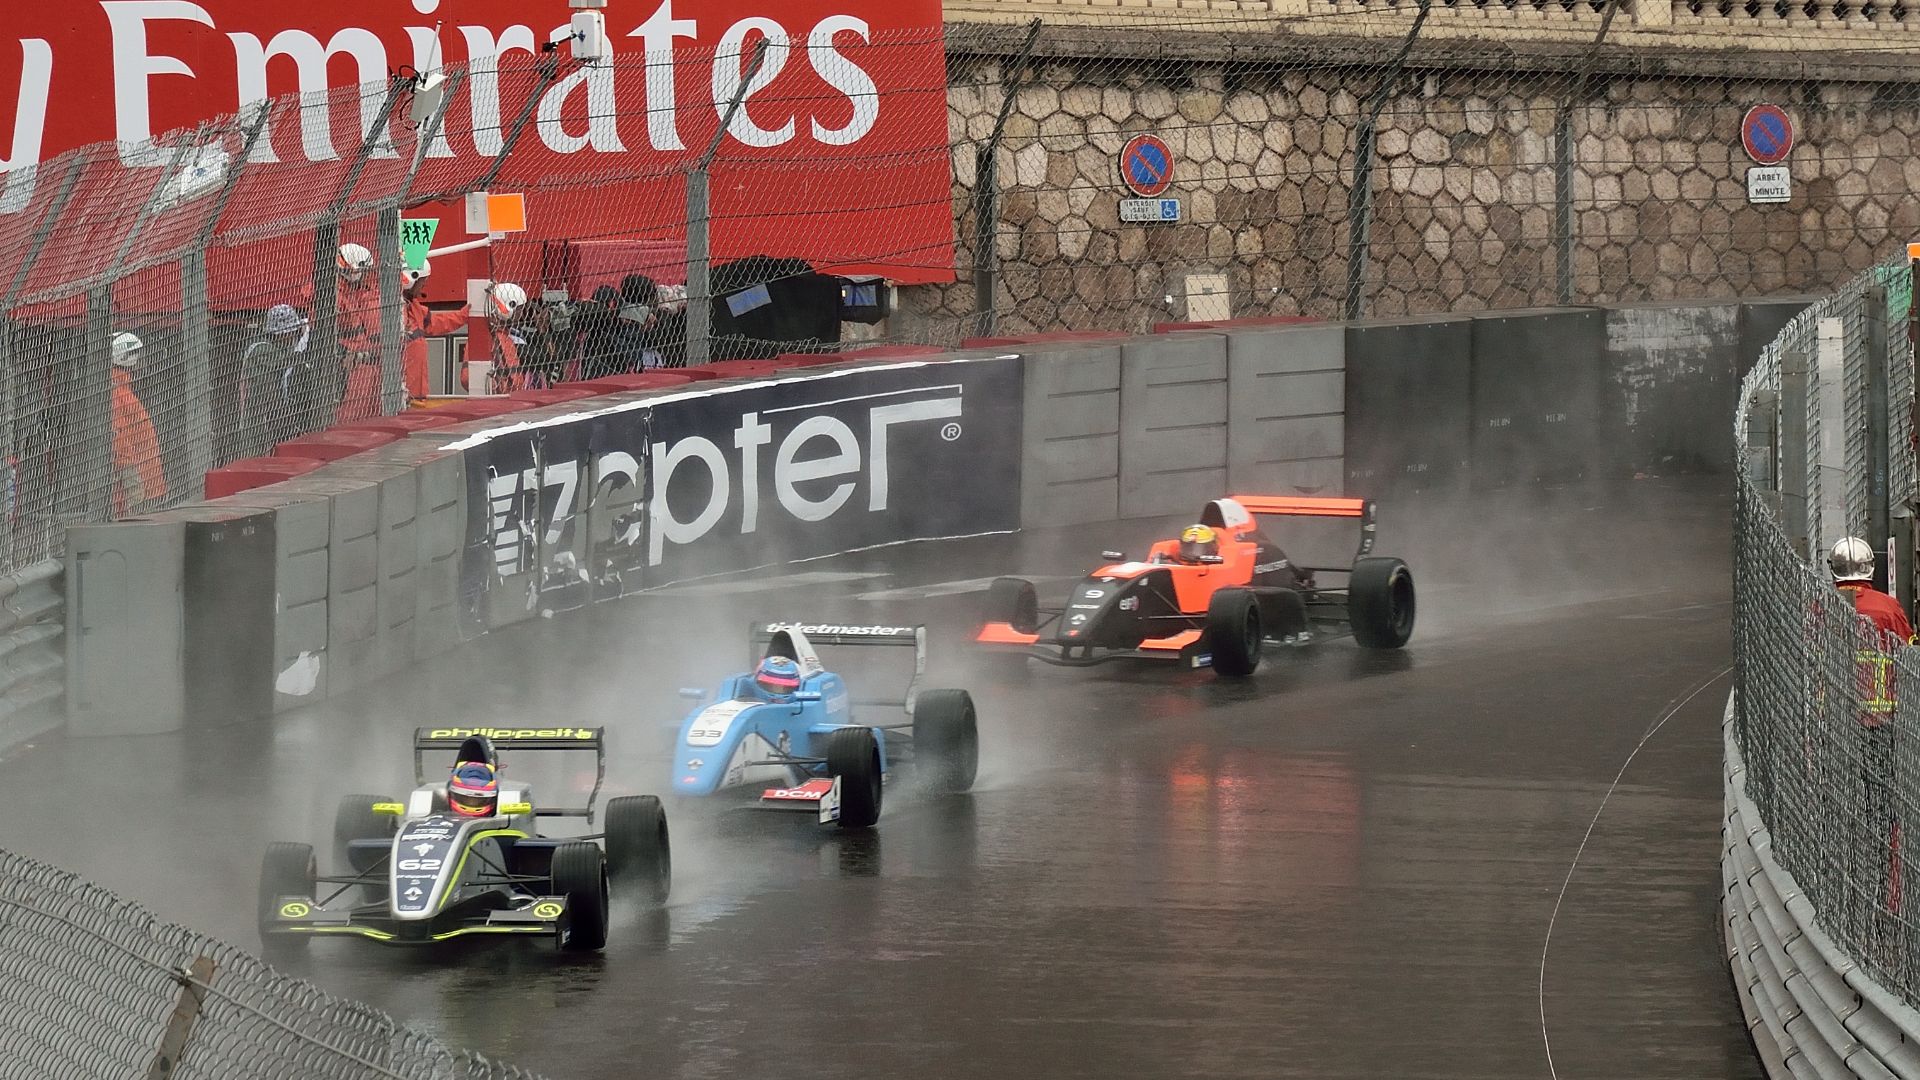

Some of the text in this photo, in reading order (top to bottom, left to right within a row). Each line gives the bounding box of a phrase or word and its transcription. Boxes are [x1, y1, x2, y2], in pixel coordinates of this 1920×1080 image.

[100, 0, 880, 167] Emirates
[1085, 589, 1105, 599] 9
[689, 729, 722, 738] 33
[775, 789, 821, 798] DCM
[398, 859, 441, 870] 62
